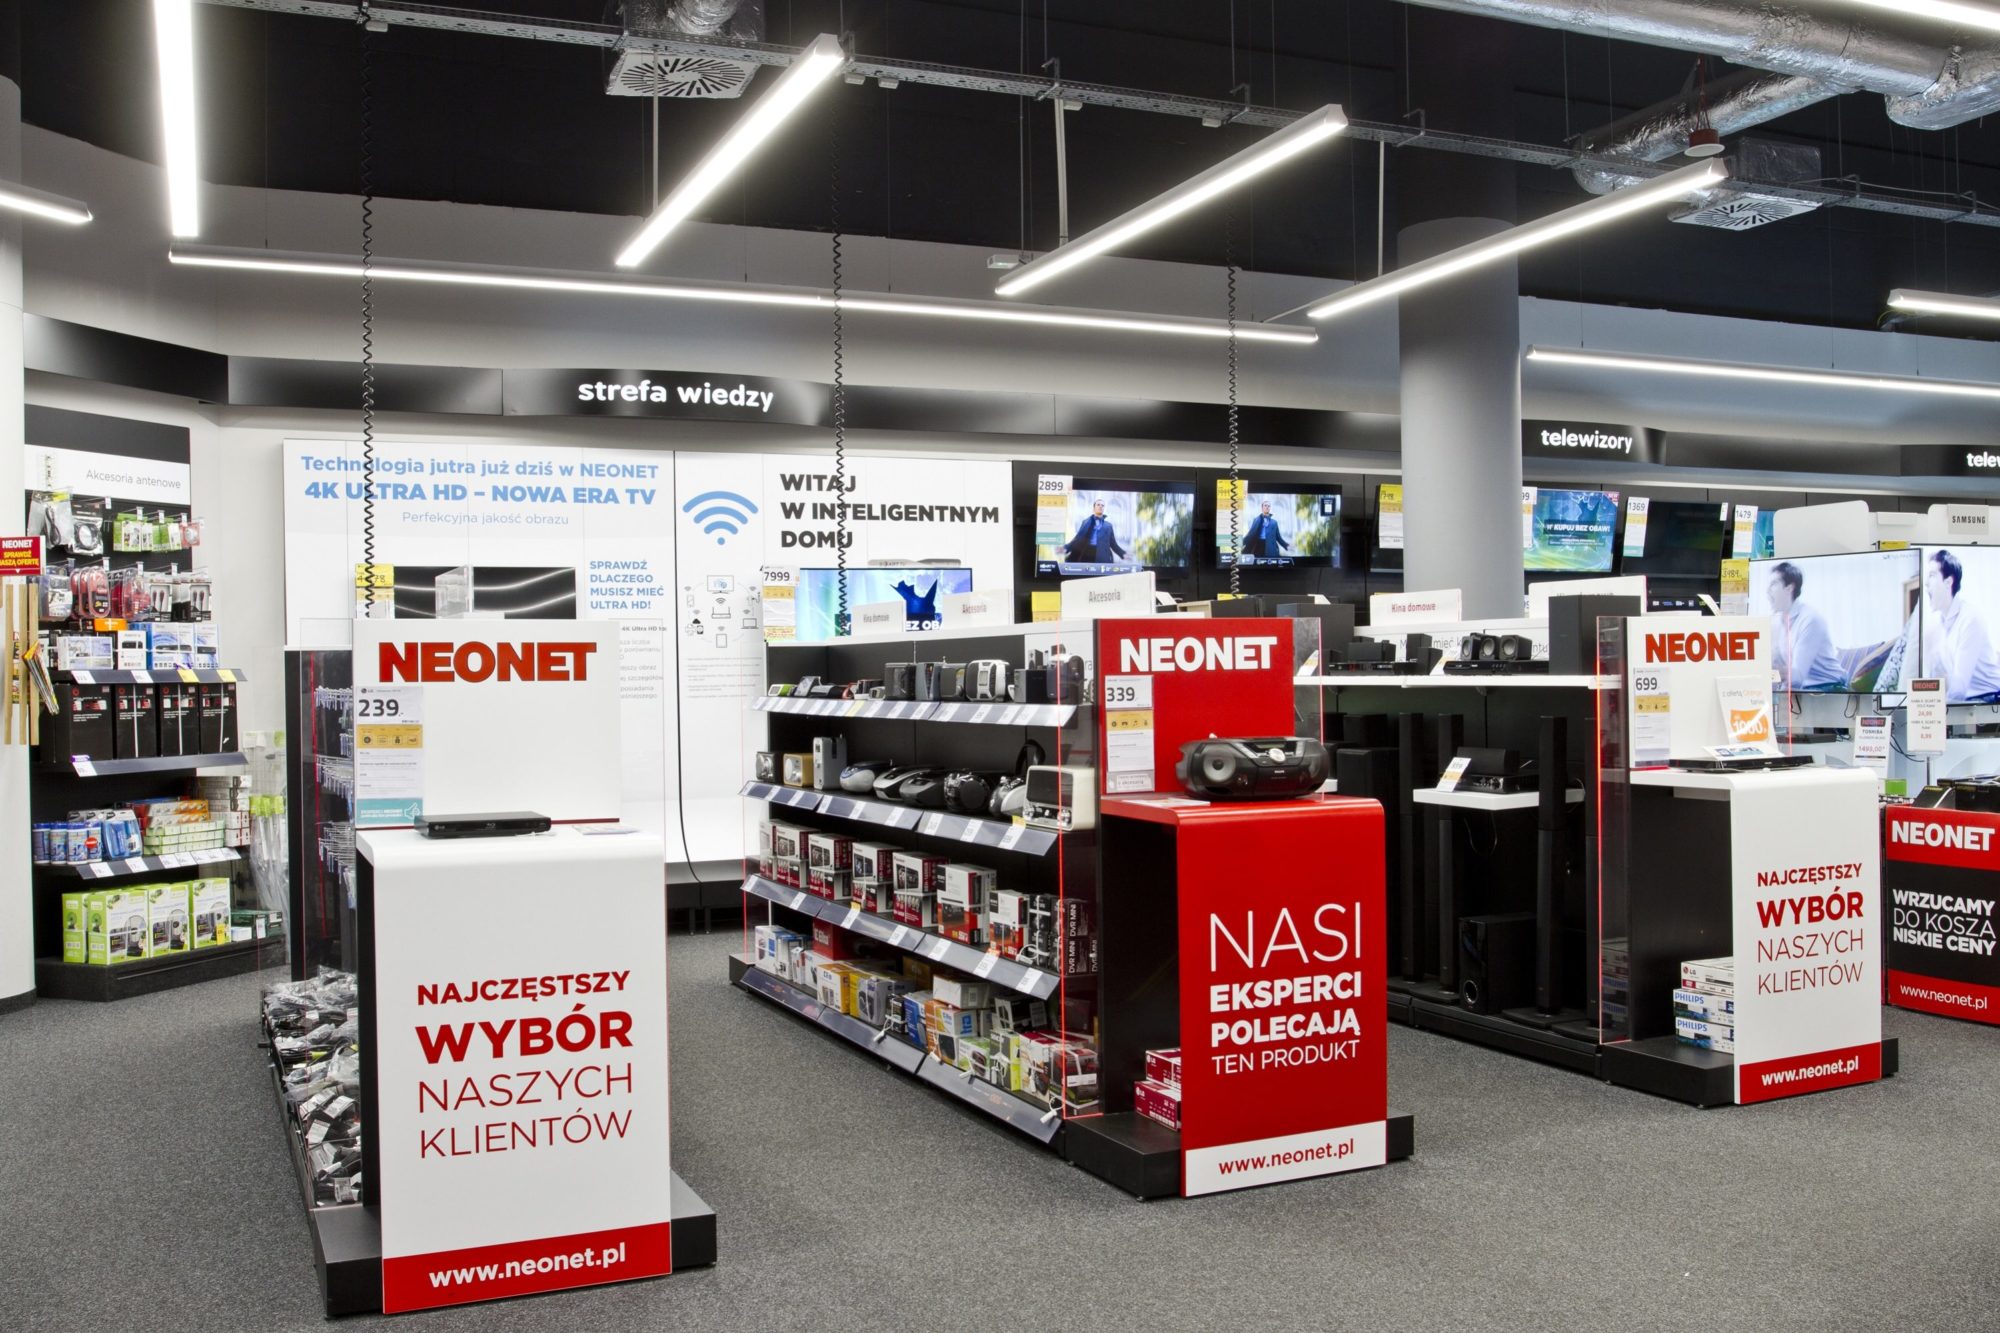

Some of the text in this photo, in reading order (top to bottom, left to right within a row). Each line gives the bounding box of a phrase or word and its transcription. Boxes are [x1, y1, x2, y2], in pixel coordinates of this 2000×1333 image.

[578, 379, 774, 412] strefa wiedzy
[1541, 428, 1633, 454] telewizory
[86, 469, 181, 489] Akcesoria antenowe
[301, 456, 659, 479] Technologia jutra już dziś w NEONET
[305, 482, 339, 499] 4K
[345, 482, 427, 500] ULTRA
[433, 484, 467, 501] HD
[492, 485, 567, 503] NOWA
[573, 487, 620, 504] ERA
[625, 489, 656, 505] TV
[780, 474, 856, 492] WITAJ
[1039, 481, 1063, 491] 2899
[402, 511, 569, 526] Perfekcyjna jakość obrazu
[780, 502, 999, 524] W INTELIGENTNYM
[1628, 503, 1645, 511] 1369
[1735, 510, 1752, 519] 1479
[1952, 515, 1986, 524] SAMSUNG
[2, 539, 33, 549] NEONET
[781, 530, 853, 548] DOMU
[590, 558, 648, 570] SPRAWDŹ
[764, 571, 790, 581] 7999
[590, 574, 653, 583] DLACZEGO
[590, 584, 664, 596] MUSISZ MIEĆ
[590, 600, 651, 610] ULTRA HD!
[1408, 602, 1436, 612] domowe
[1120, 636, 1278, 673] NEONET
[1644, 631, 1760, 663] NEONET
[378, 641, 597, 683] NEONET
[1106, 686, 1136, 702] 339
[1635, 677, 1658, 691] 699
[1891, 820, 1995, 852] NEONET
[1757, 863, 1863, 887] NAJCZĘSTSZY
[1756, 886, 1864, 928] WYBÓR
[1893, 888, 1995, 917] WRZUCAMY
[1209, 901, 1361, 972] NASI
[1893, 908, 1997, 939] DO KOSZA
[1757, 928, 1864, 963] NASZYCH
[1893, 926, 1997, 956] NISKIE CENY
[417, 970, 631, 1006] NAJCZĘSTSZY
[1757, 961, 1864, 995] KLIENTÓW
[1210, 971, 1362, 1013] EKSPERCI
[1675, 991, 1705, 1005] PHILIPS
[1900, 984, 1988, 1011] www.neonet.pl
[415, 1003, 633, 1064] WYBÓR
[1211, 1008, 1361, 1048] POLECAJĄ
[1677, 1019, 1708, 1032] PHILIPS
[1211, 1039, 1360, 1075] TEN PRODUKT
[1762, 1055, 1859, 1086] www.neonet.pl
[418, 1062, 632, 1114] NASZYCH
[420, 1107, 633, 1159] KLIENTÓW
[1218, 1138, 1354, 1174] www.neonet.pl
[428, 1242, 626, 1288] www.neonet.pl
